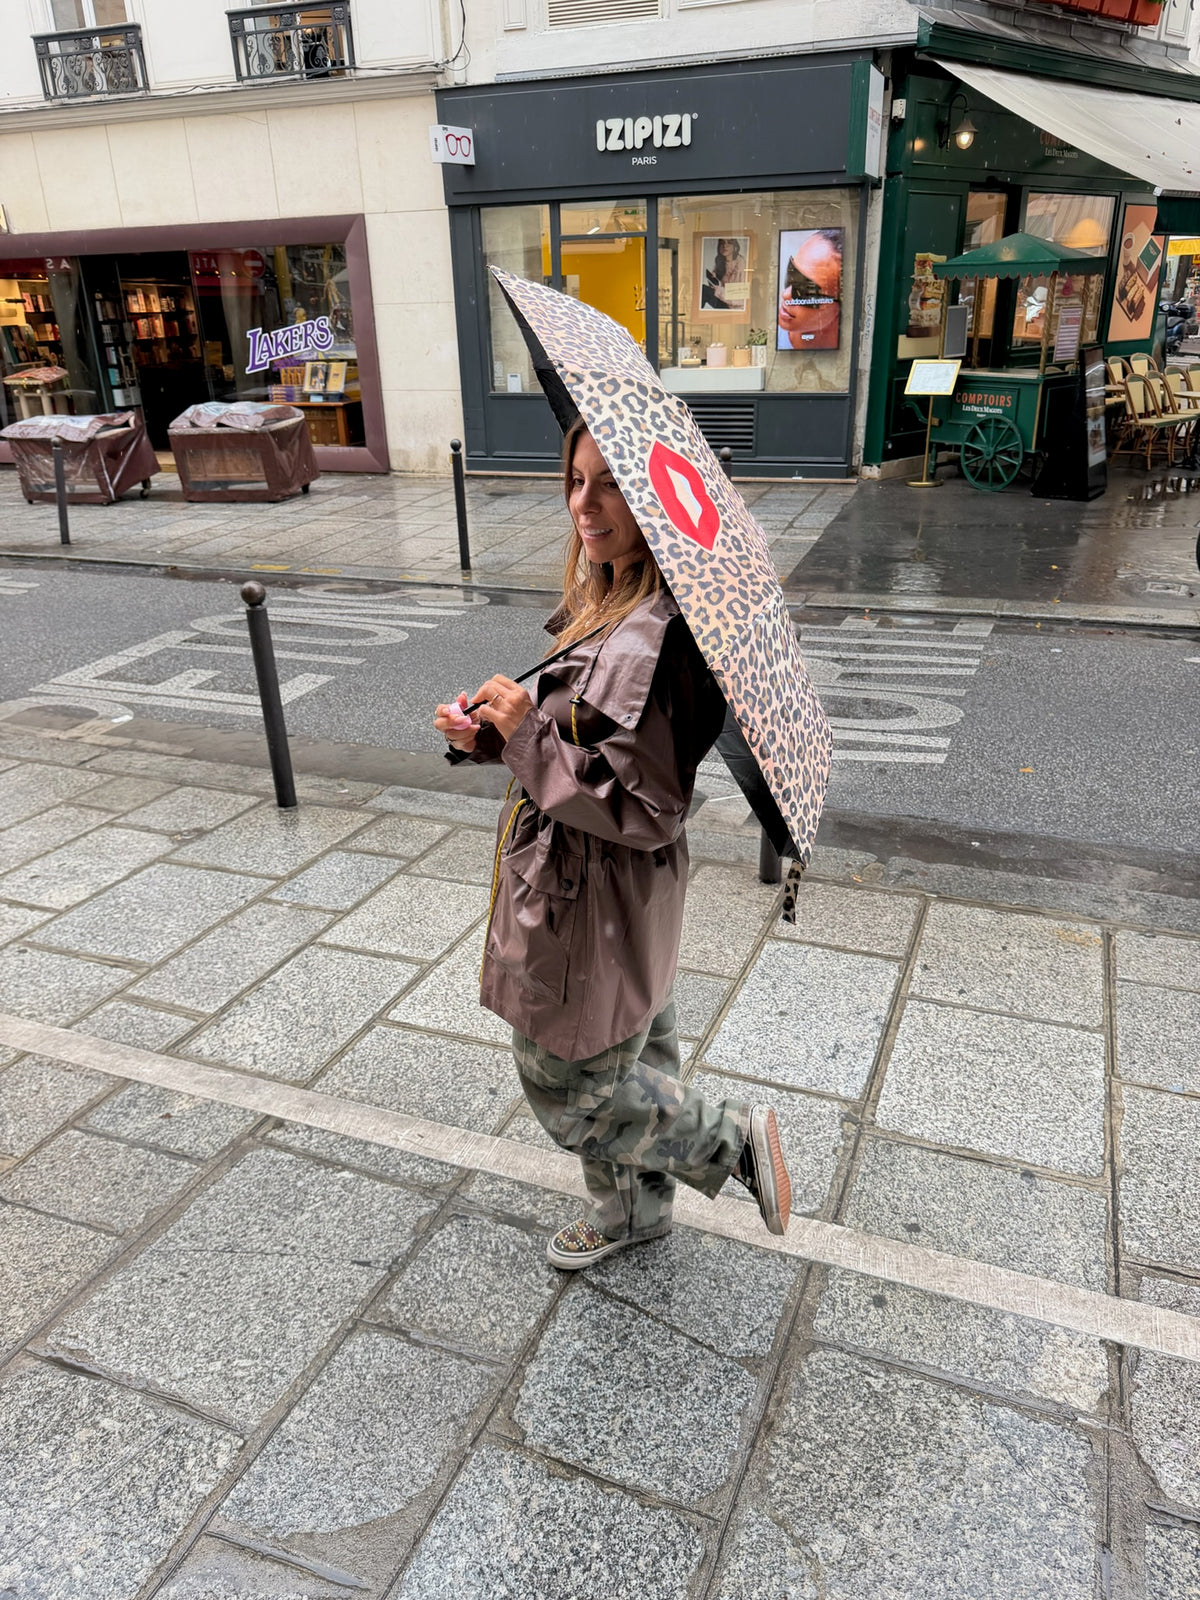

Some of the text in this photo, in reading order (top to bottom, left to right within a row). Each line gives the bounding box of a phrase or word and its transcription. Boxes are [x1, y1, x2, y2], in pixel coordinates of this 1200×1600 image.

[631, 156, 658, 166] PARIS
[245, 316, 334, 374] LAKERS
[955, 392, 1012, 408] COMPTOIRS
